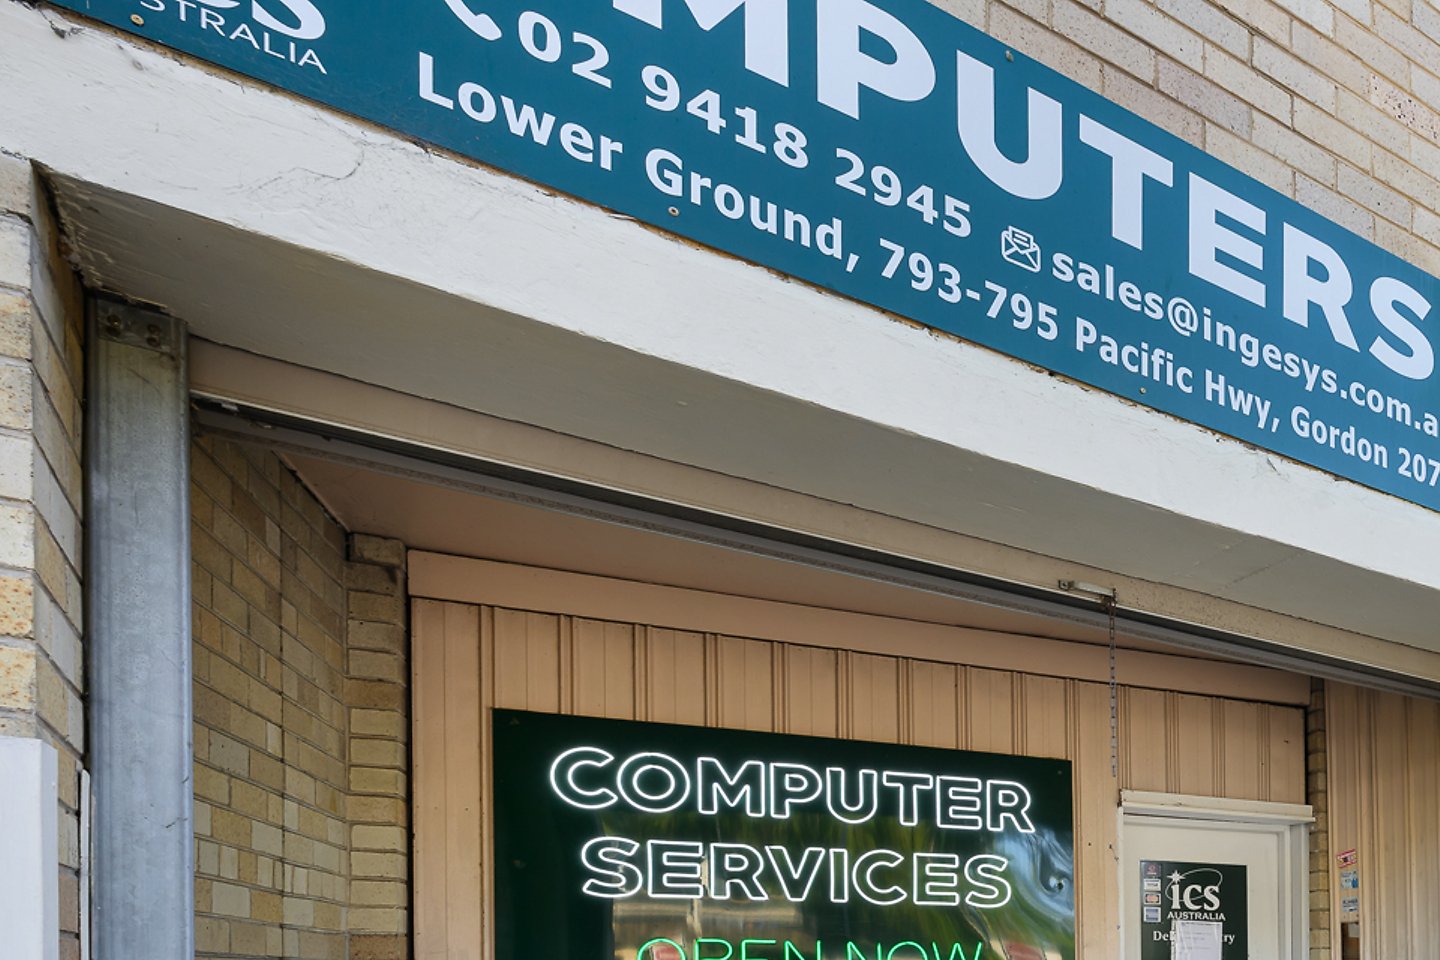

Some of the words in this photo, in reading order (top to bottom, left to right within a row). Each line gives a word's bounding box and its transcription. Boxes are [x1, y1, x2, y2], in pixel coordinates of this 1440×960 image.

[517, 10, 613, 89] 02
[640, 65, 810, 169] 9418
[834, 148, 972, 238] 2945
[612, 0, 1435, 381] MPUTERS
[418, 51, 624, 171] Lower
[645, 148, 861, 273] Ground,
[879, 237, 1059, 341] 793-795
[1076, 316, 1194, 394] Pacific
[1204, 368, 1282, 433] Hwy,
[1290, 405, 1389, 469] Gordon
[549, 745, 1036, 834] COMPUTER
[579, 835, 1013, 909] SERVICES
[1166, 911, 1226, 921] AUSTRALIA
